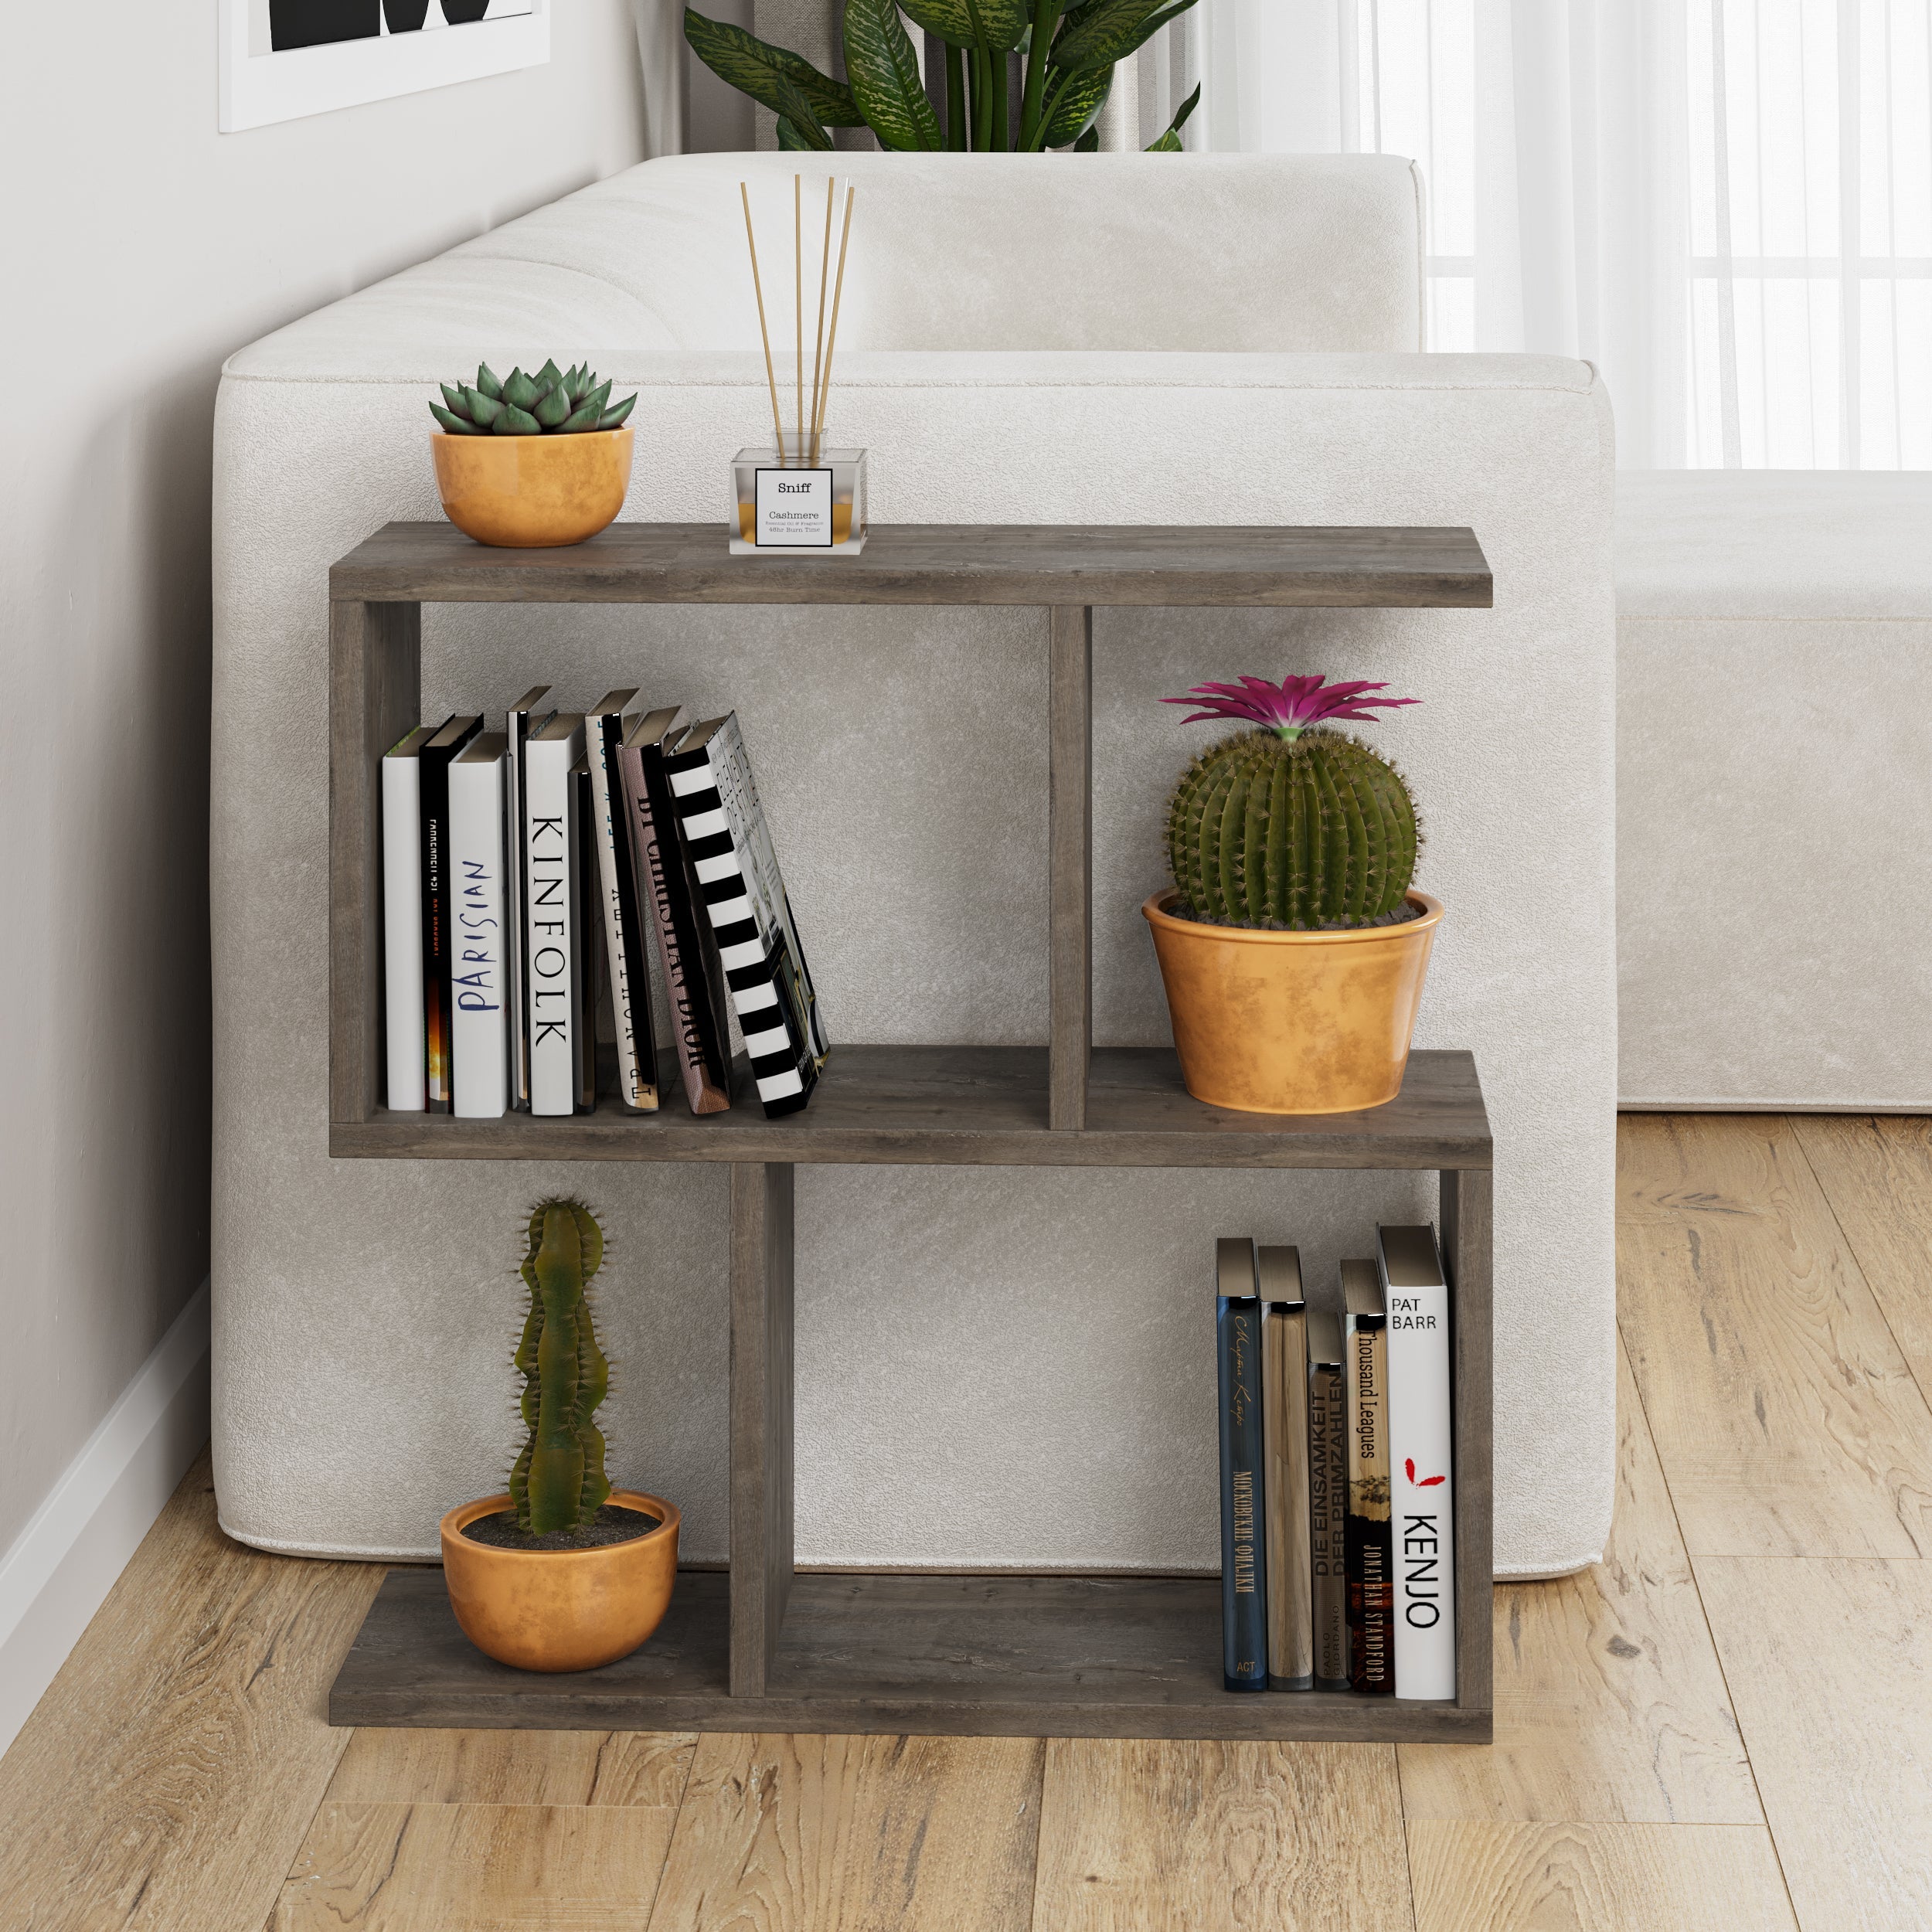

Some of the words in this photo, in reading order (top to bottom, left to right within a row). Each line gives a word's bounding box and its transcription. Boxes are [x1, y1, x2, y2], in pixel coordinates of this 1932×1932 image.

[769, 511, 819, 519] Cashmere
[778, 482, 811, 493] Sniff
[452, 861, 499, 1012] PARISIAN
[532, 815, 566, 1047] KINFOLK
[1392, 1298, 1421, 1311] PAT
[1392, 1316, 1437, 1330] BARR
[1359, 1330, 1378, 1398] Thousand
[1329, 1372, 1344, 1522] PRIMZAHLEN
[1356, 1402, 1377, 1458] Leagues
[1312, 1391, 1328, 1531] EINSAMKEIT
[1233, 1471, 1253, 1541] МОСКОВСКИЕ
[1234, 1545, 1254, 1593] ФИАЛКИ
[1315, 1539, 1328, 1577] DIE
[1332, 1529, 1345, 1577] DER
[1363, 1545, 1383, 1606] JONATHAN
[1403, 1515, 1440, 1629] KENJO
[1365, 1614, 1384, 1681] STANDFORD
